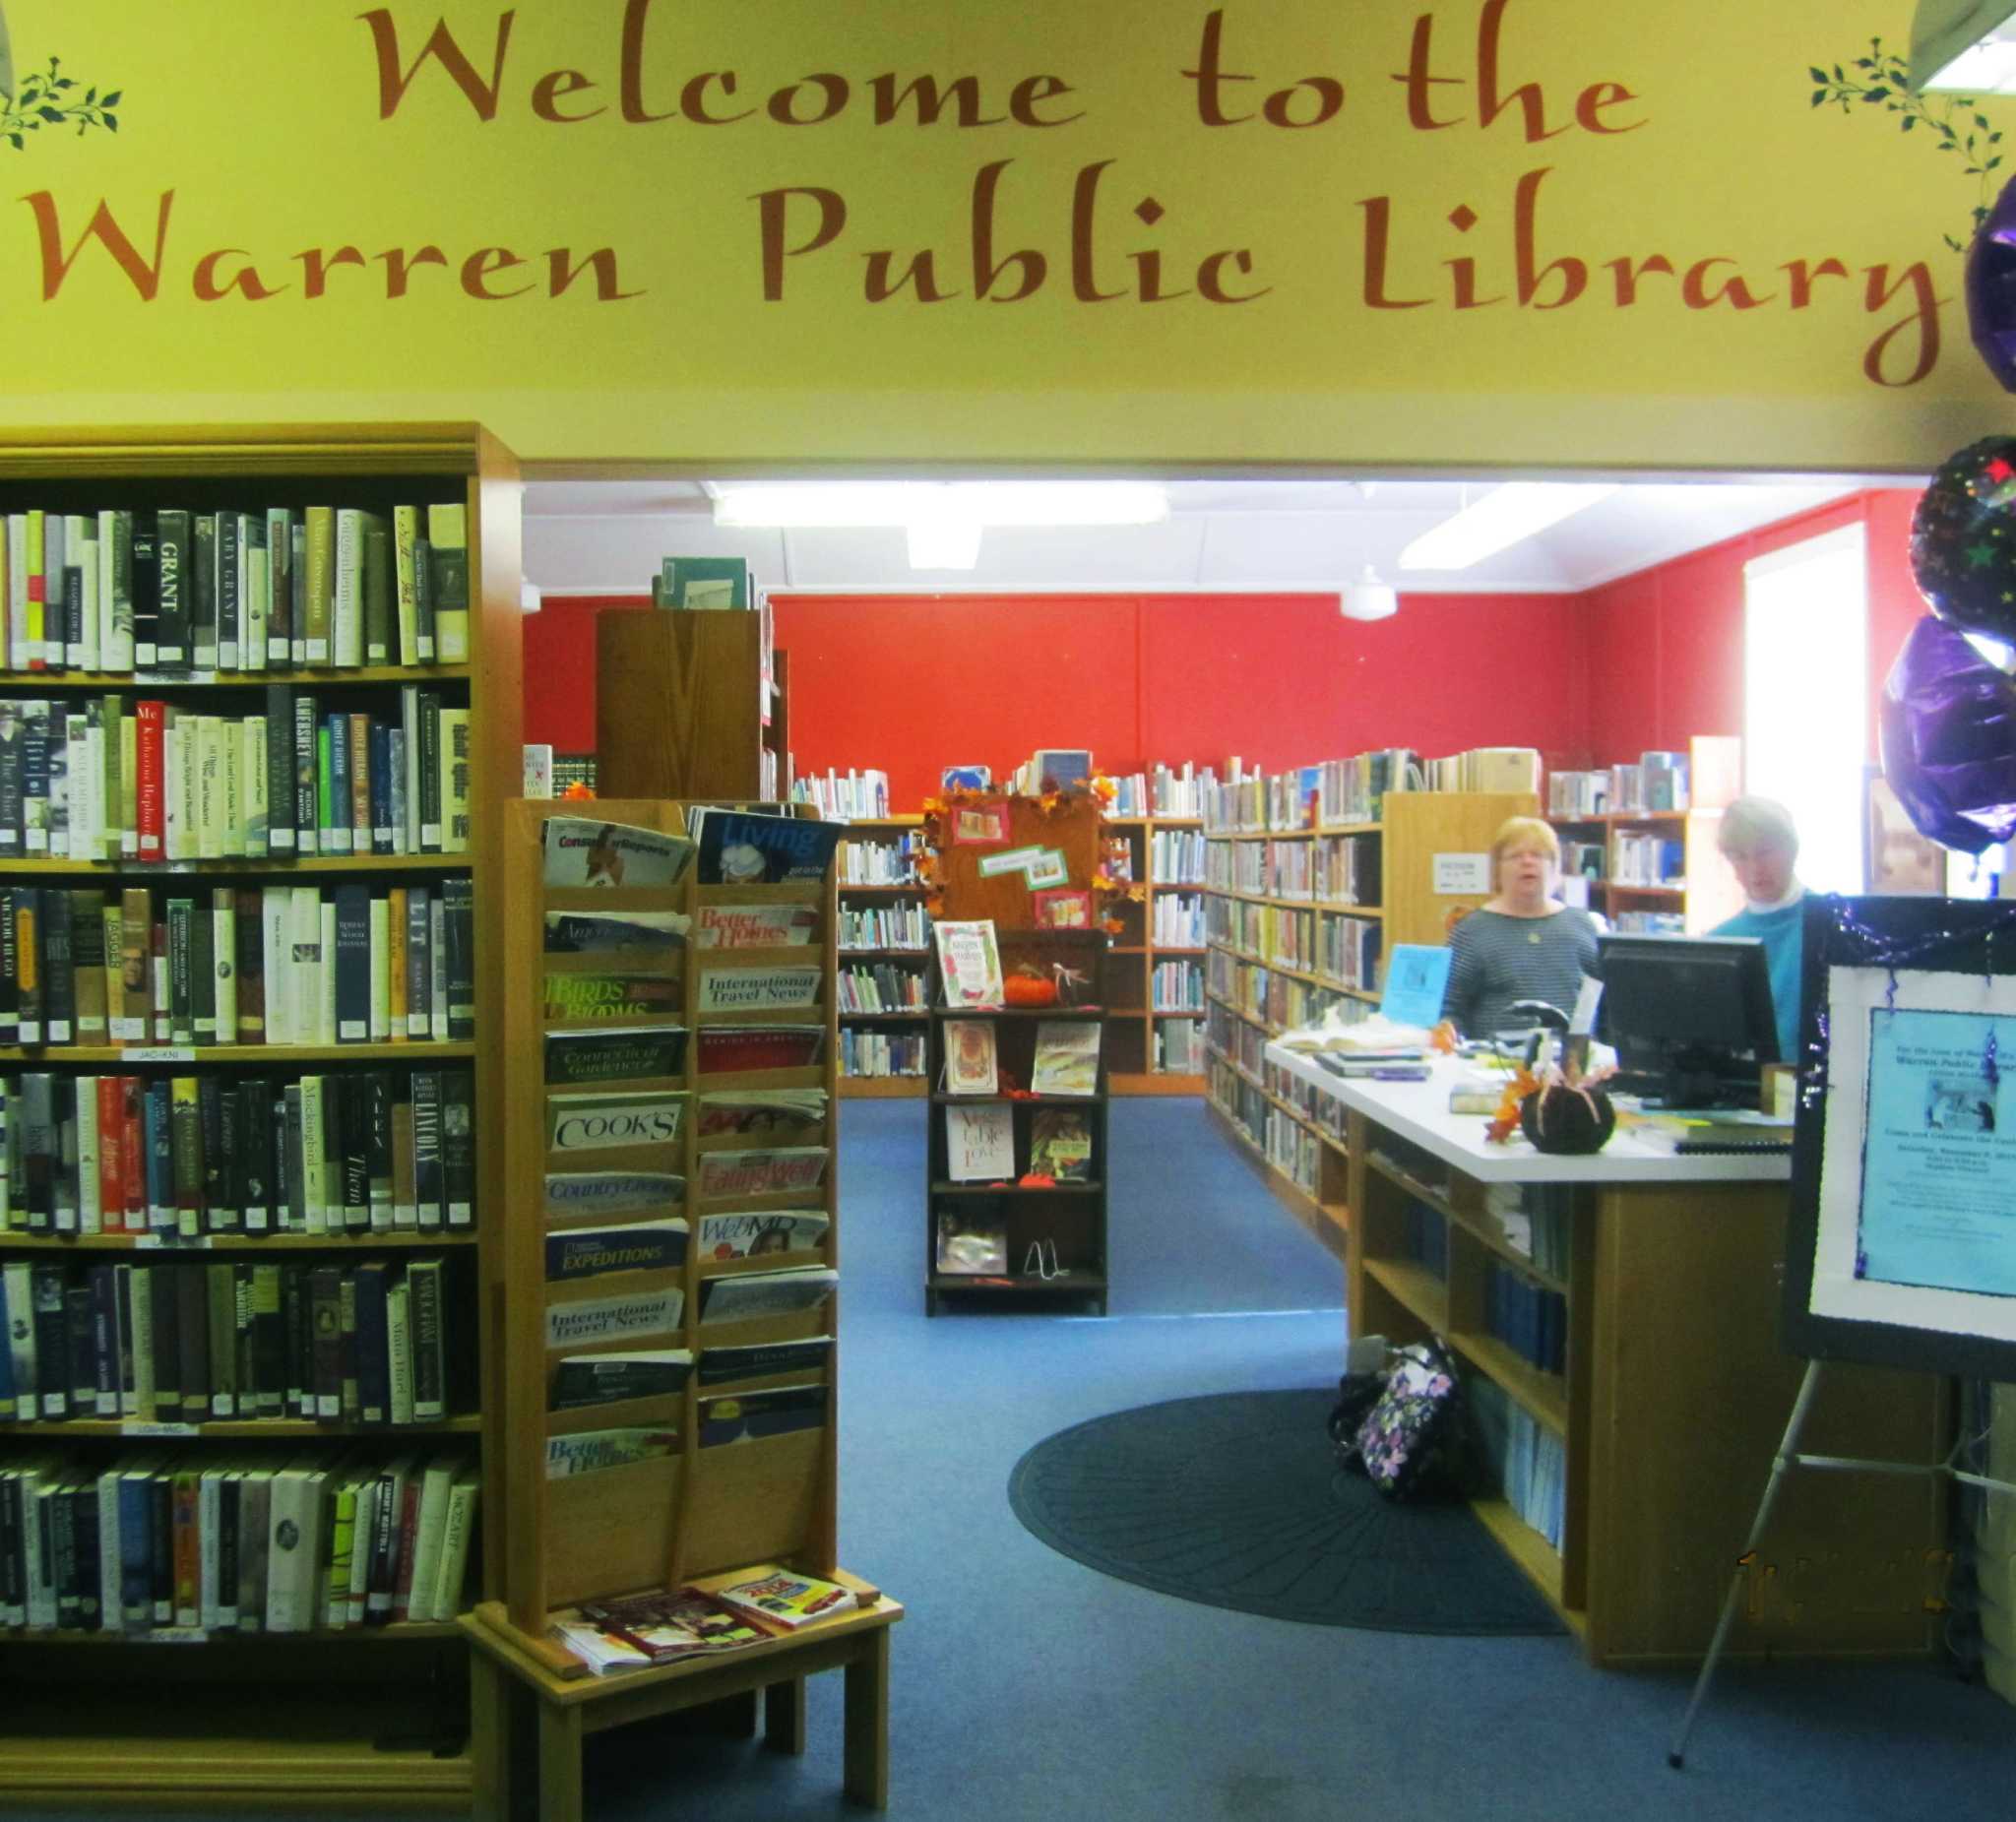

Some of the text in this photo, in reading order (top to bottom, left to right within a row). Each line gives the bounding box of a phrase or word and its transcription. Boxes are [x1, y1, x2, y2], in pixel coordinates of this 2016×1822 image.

[355, 0, 1650, 144] Welcome to the
[17, 158, 1952, 388] Warren Public Library
[161, 541, 177, 611] GRANT
[223, 570, 235, 620] GRANT
[138, 707, 157, 720] Me
[4, 751, 17, 823] The Chief
[141, 784, 154, 838] Hepburn
[724, 816, 819, 857] Living
[3, 895, 14, 976] VICTOR HUGO
[410, 902, 425, 946] LIT
[700, 911, 761, 929] Better
[719, 925, 788, 948] Homes
[554, 980, 624, 1002] BIRDS
[709, 975, 814, 992] International
[711, 986, 807, 1003] Travel News
[1896, 1056, 1975, 1068] Warren Public
[304, 1085, 316, 1166] Mockingbird
[415, 1103, 438, 1162] LINCOLN
[555, 1110, 675, 1148] COOK'S
[348, 1155, 365, 1204] Them
[703, 1216, 798, 1242] WebMD
[563, 1244, 663, 1271] EXPEDITIONS
[237, 1280, 247, 1328] WARRIOR
[551, 1300, 666, 1327] International
[393, 1322, 404, 1356] Mata
[553, 1313, 662, 1339] Travel News
[382, 1481, 392, 1513] TOMMY
[448, 1493, 466, 1549] MOZART
